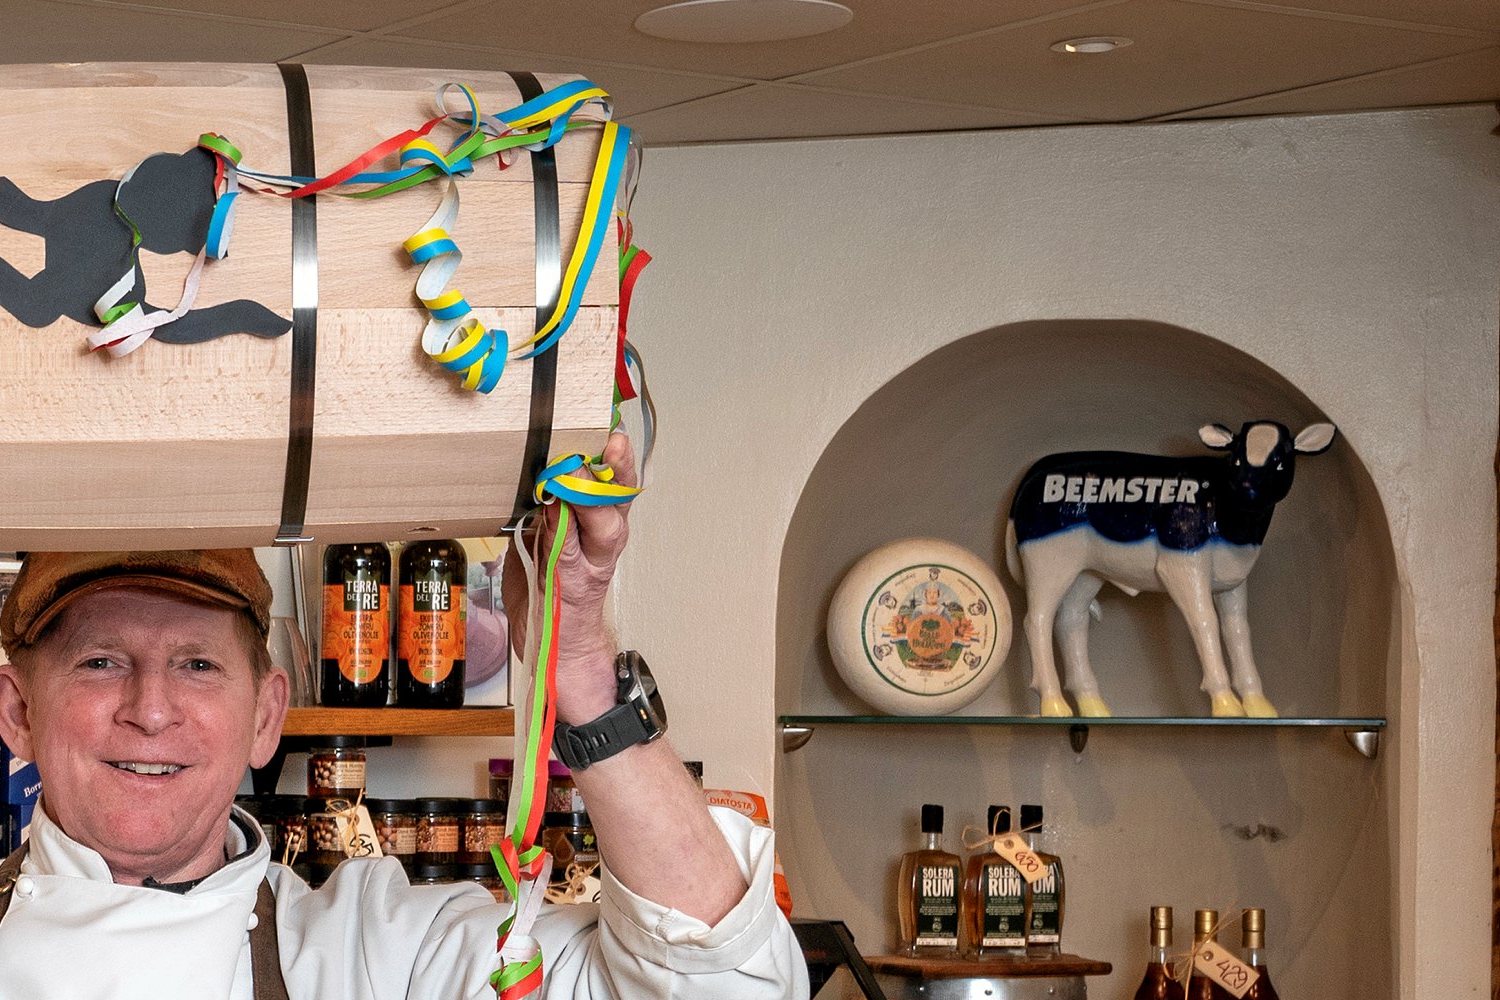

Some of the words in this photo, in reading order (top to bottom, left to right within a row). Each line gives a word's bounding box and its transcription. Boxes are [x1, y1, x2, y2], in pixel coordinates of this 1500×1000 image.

[1042, 473, 1200, 505] BEEMSTER
[346, 580, 378, 593] TERRA
[416, 580, 448, 594] TERRA
[363, 594, 378, 609] RE
[417, 593, 429, 602] DEL
[432, 594, 449, 610] RE
[922, 867, 954, 879] SOLERA
[922, 879, 954, 897] RUM
[988, 879, 1021, 897] RUM
